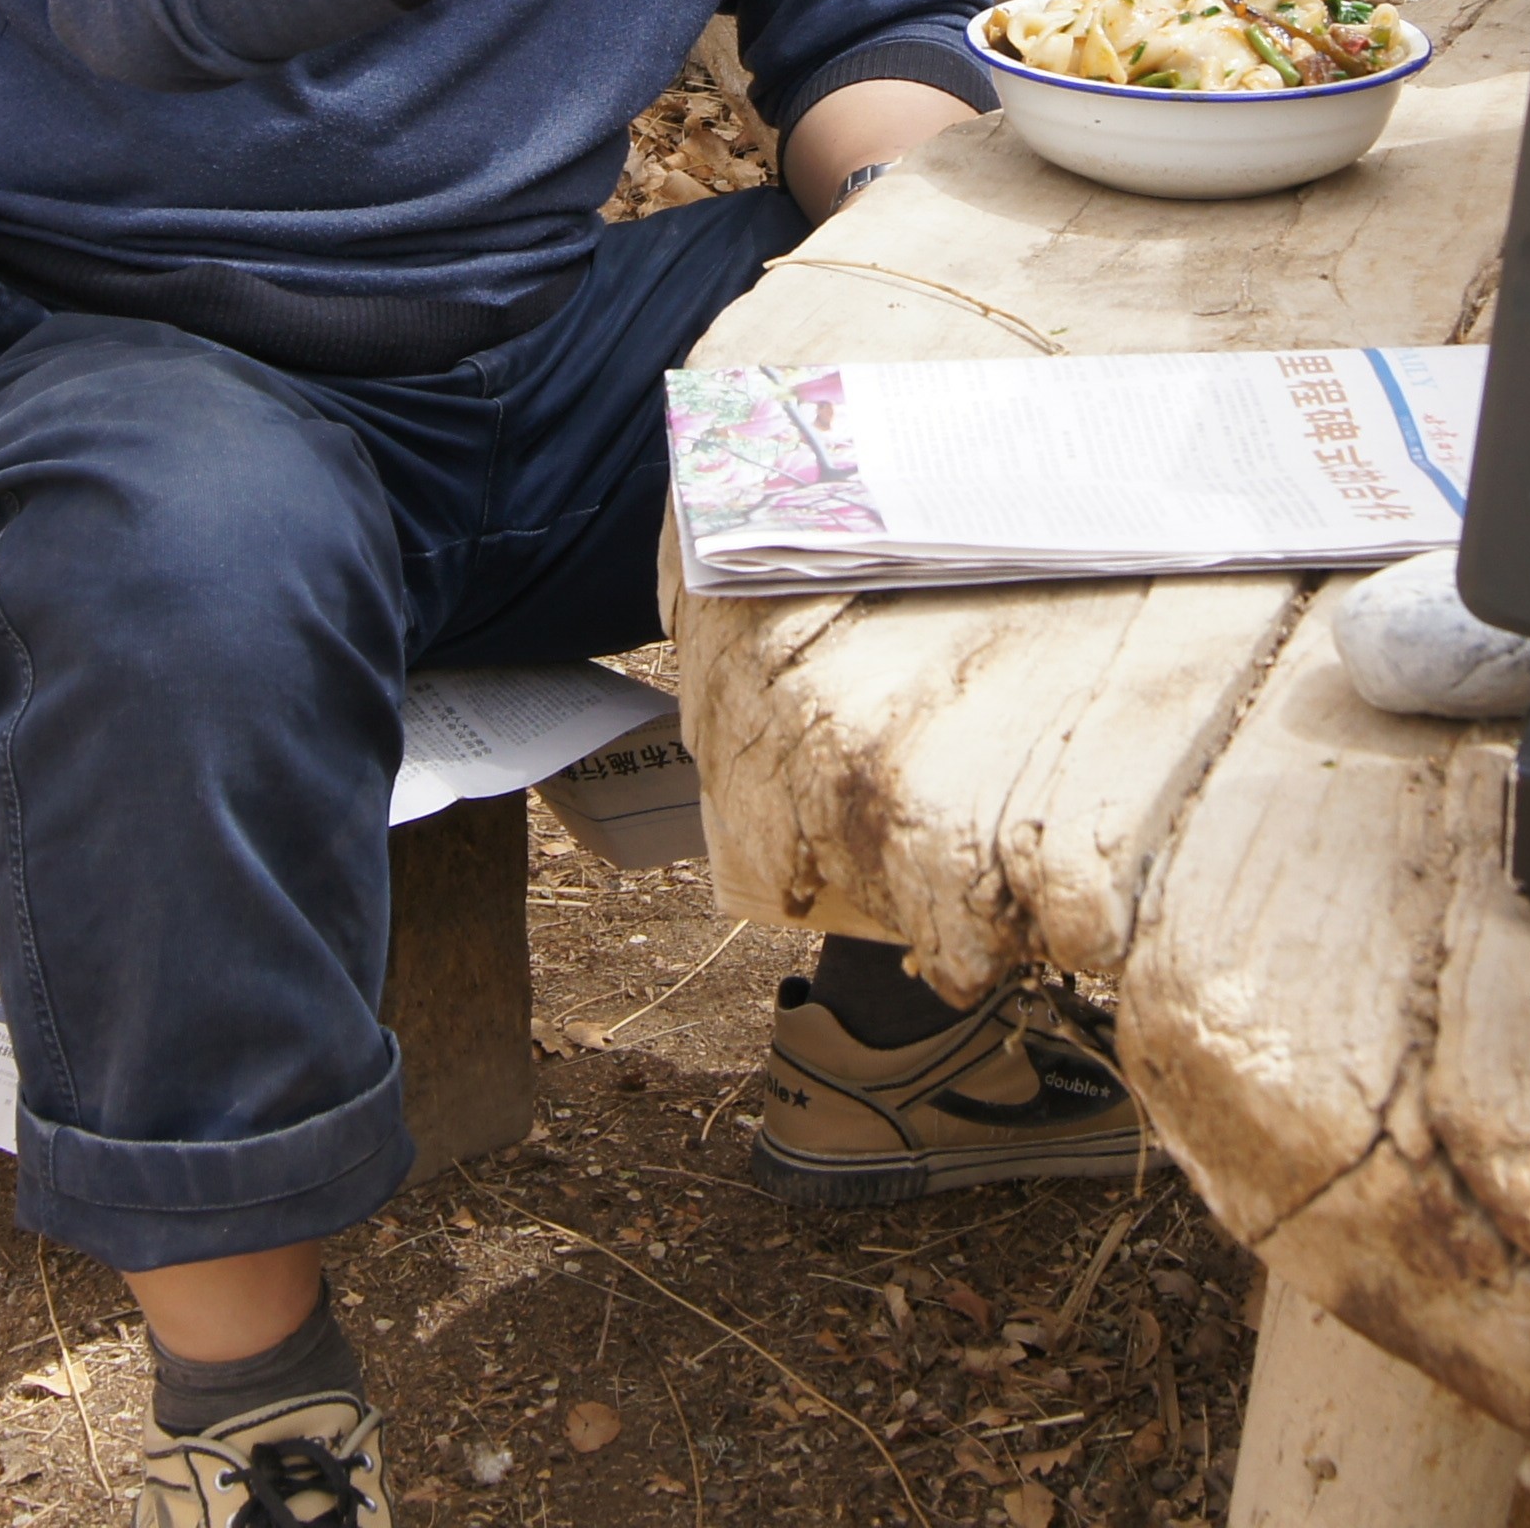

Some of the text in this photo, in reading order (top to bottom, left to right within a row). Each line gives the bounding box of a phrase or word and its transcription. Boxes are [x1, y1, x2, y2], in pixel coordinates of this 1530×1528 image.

[1392, 346, 1439, 390] AILY
[1275, 355, 1415, 521] 里程碑式的合作
[1044, 1071, 1099, 1099] double
